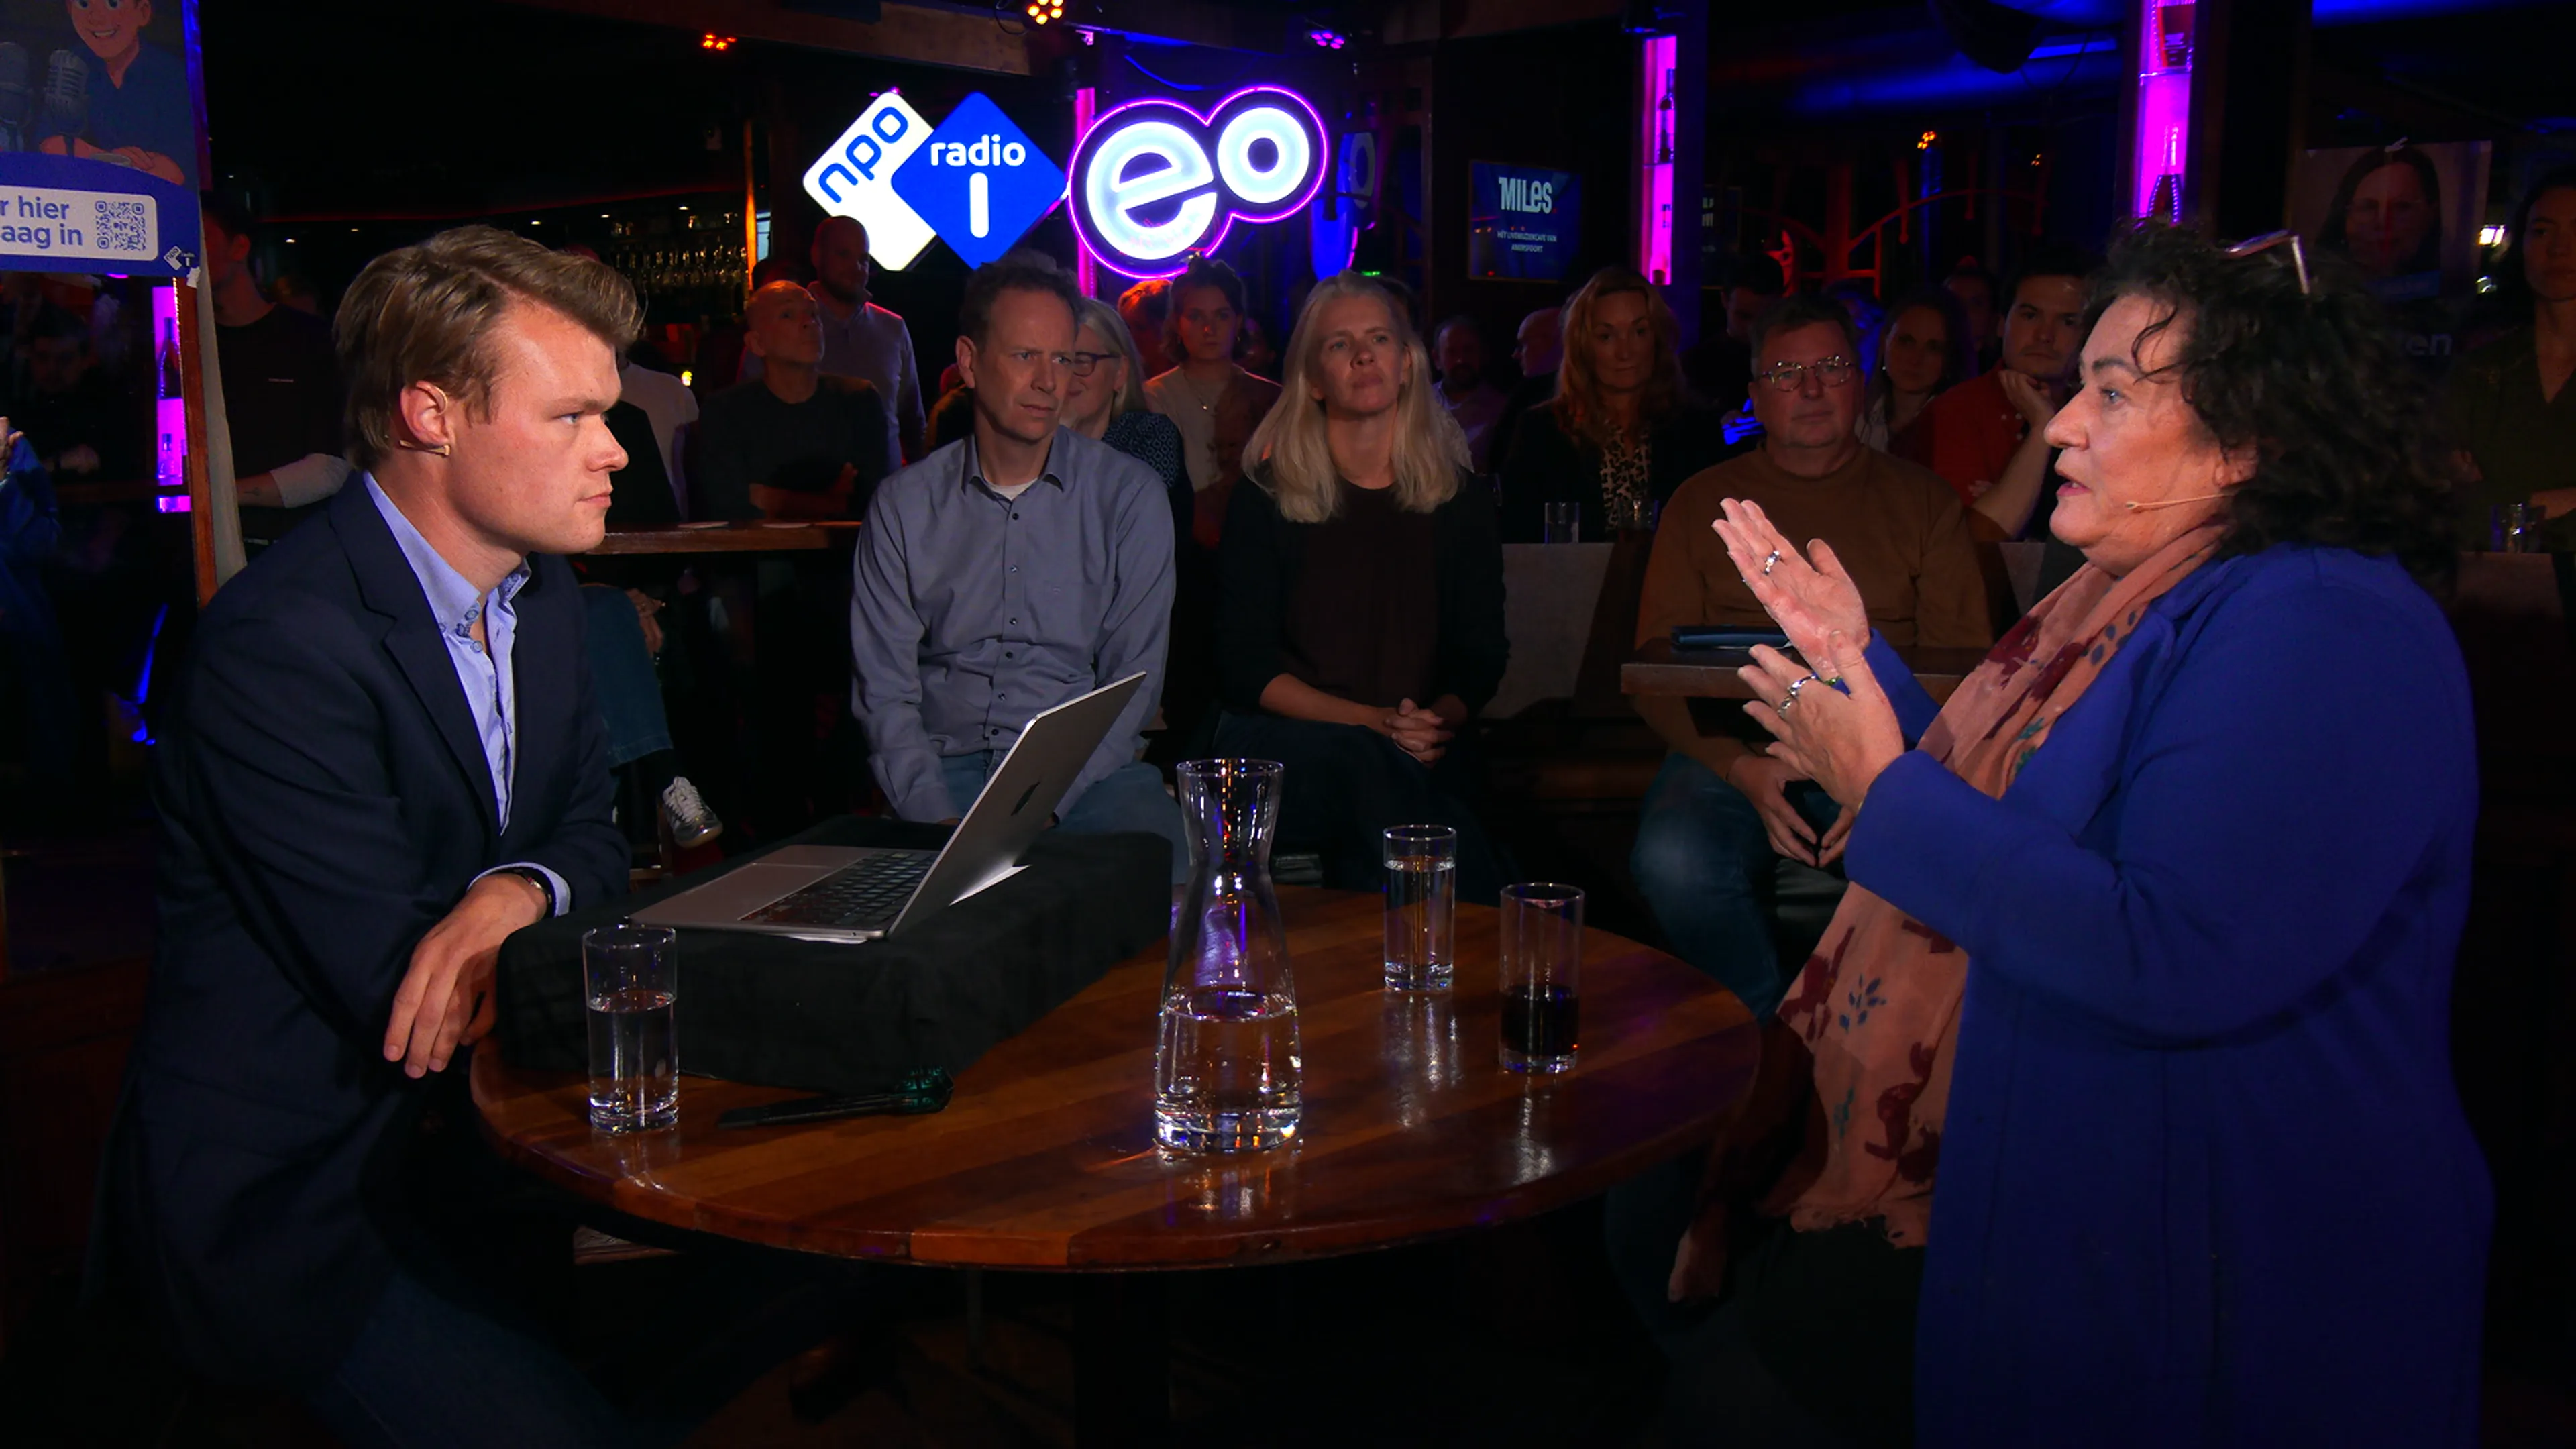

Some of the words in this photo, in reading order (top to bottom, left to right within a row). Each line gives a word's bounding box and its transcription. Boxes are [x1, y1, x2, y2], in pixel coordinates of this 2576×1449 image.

[818, 107, 908, 203] npo
[930, 134, 1026, 166] radio
[1086, 107, 1310, 260] eo
[18, 195, 70, 219] hier
[1, 225, 51, 249] aag
[60, 223, 83, 246] in
